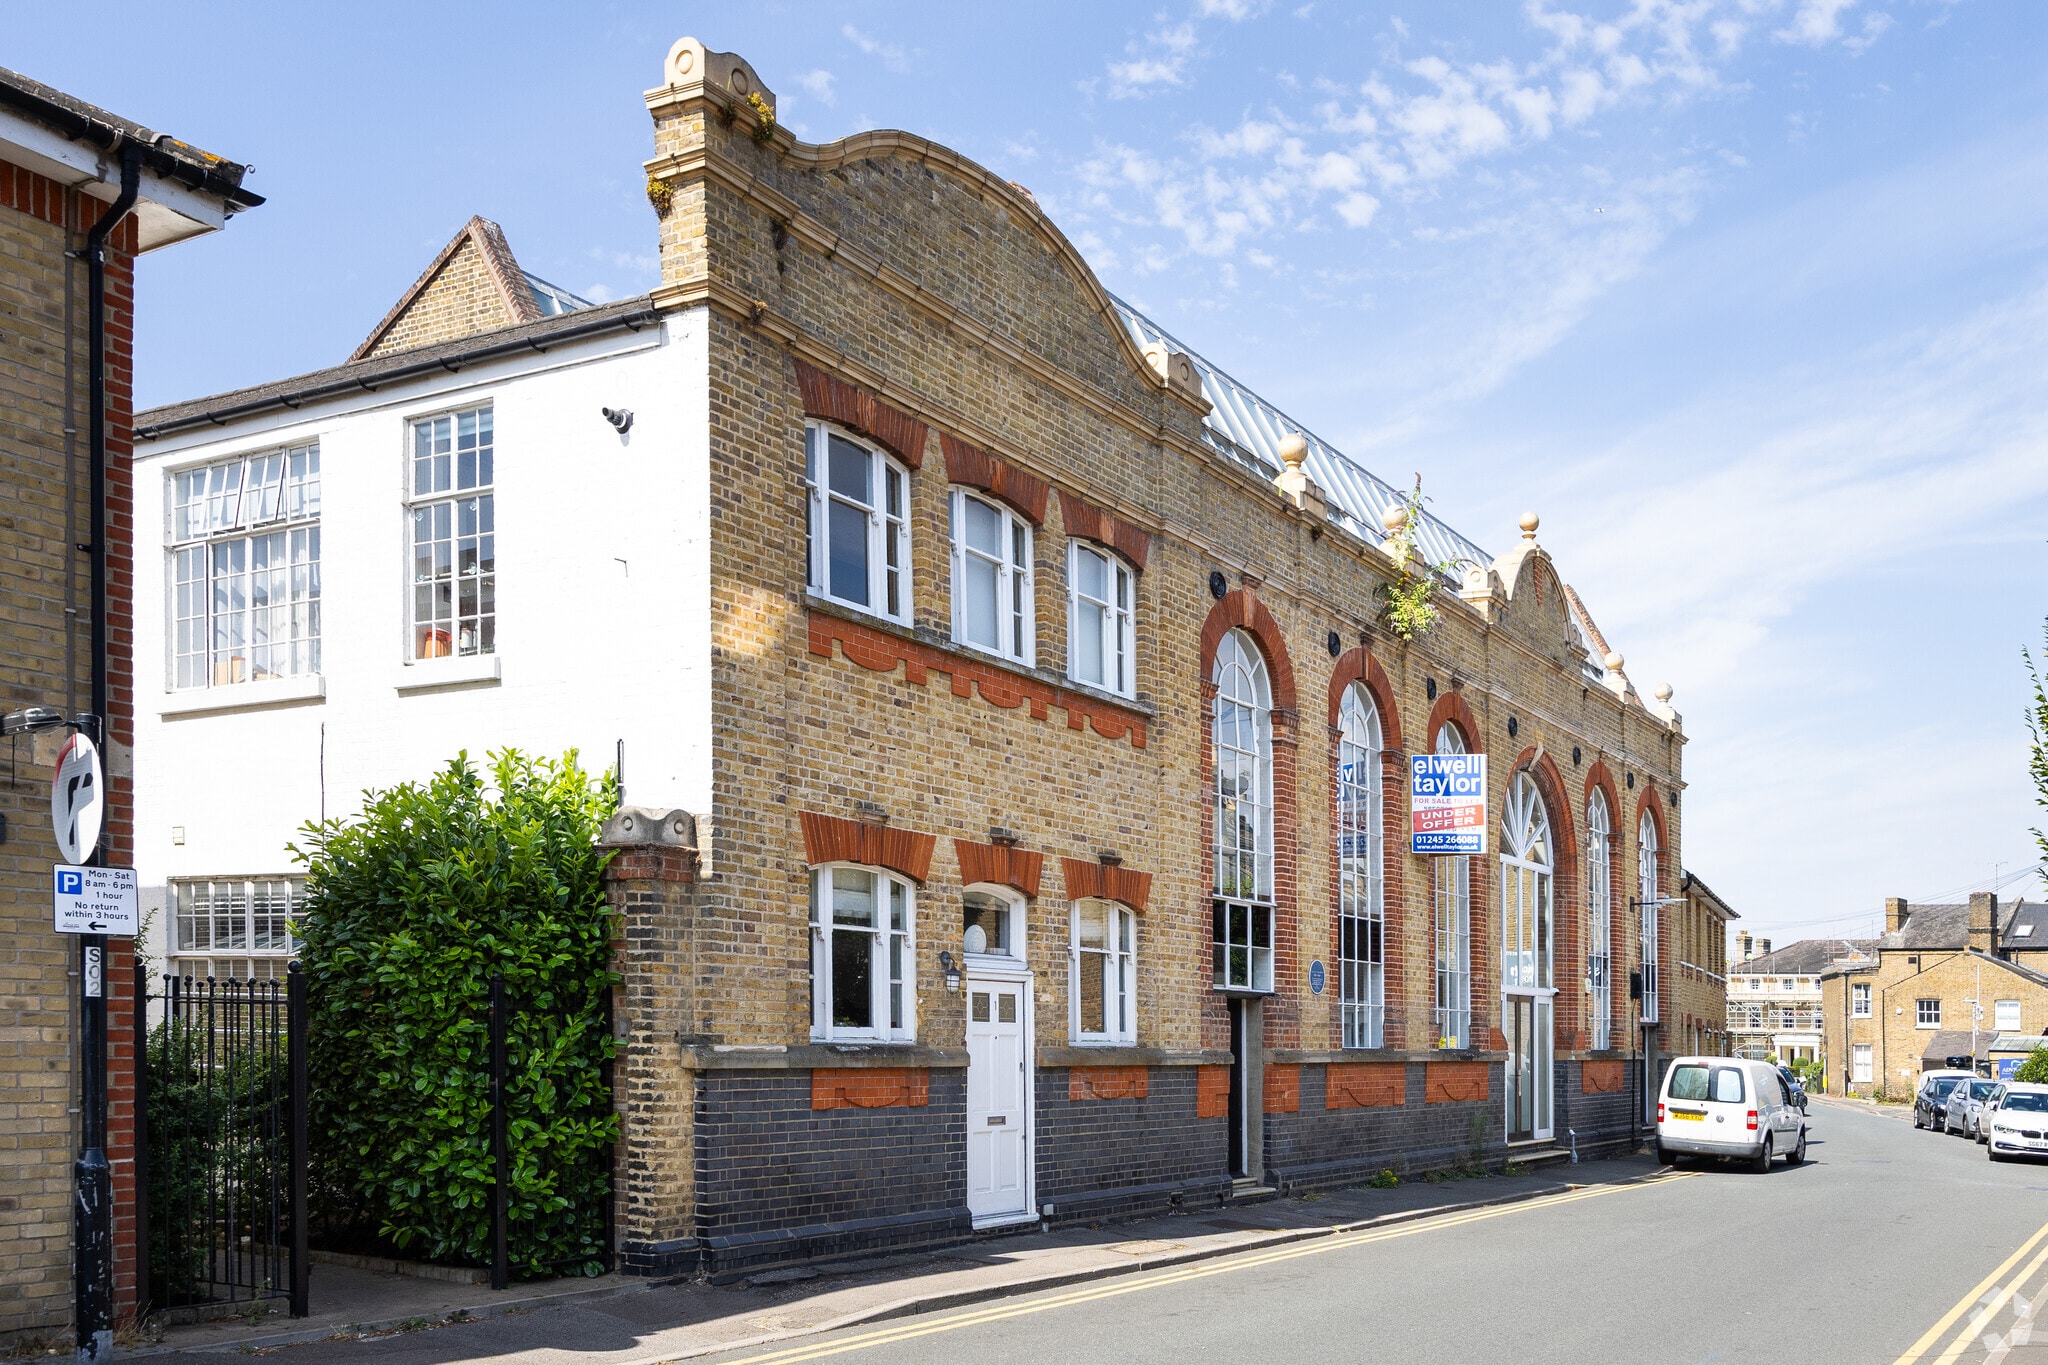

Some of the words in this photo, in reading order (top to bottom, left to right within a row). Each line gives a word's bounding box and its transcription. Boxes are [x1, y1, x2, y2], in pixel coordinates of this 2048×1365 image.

[1414, 756, 1479, 774] elwell
[1414, 773, 1480, 797] taylor
[1421, 807, 1476, 820] UNDER
[1422, 817, 1475, 829] OFFER
[88, 870, 107, 878] Mon
[114, 872, 130, 880] Sat
[63, 873, 79, 892] P
[64, 910, 92, 918] within
